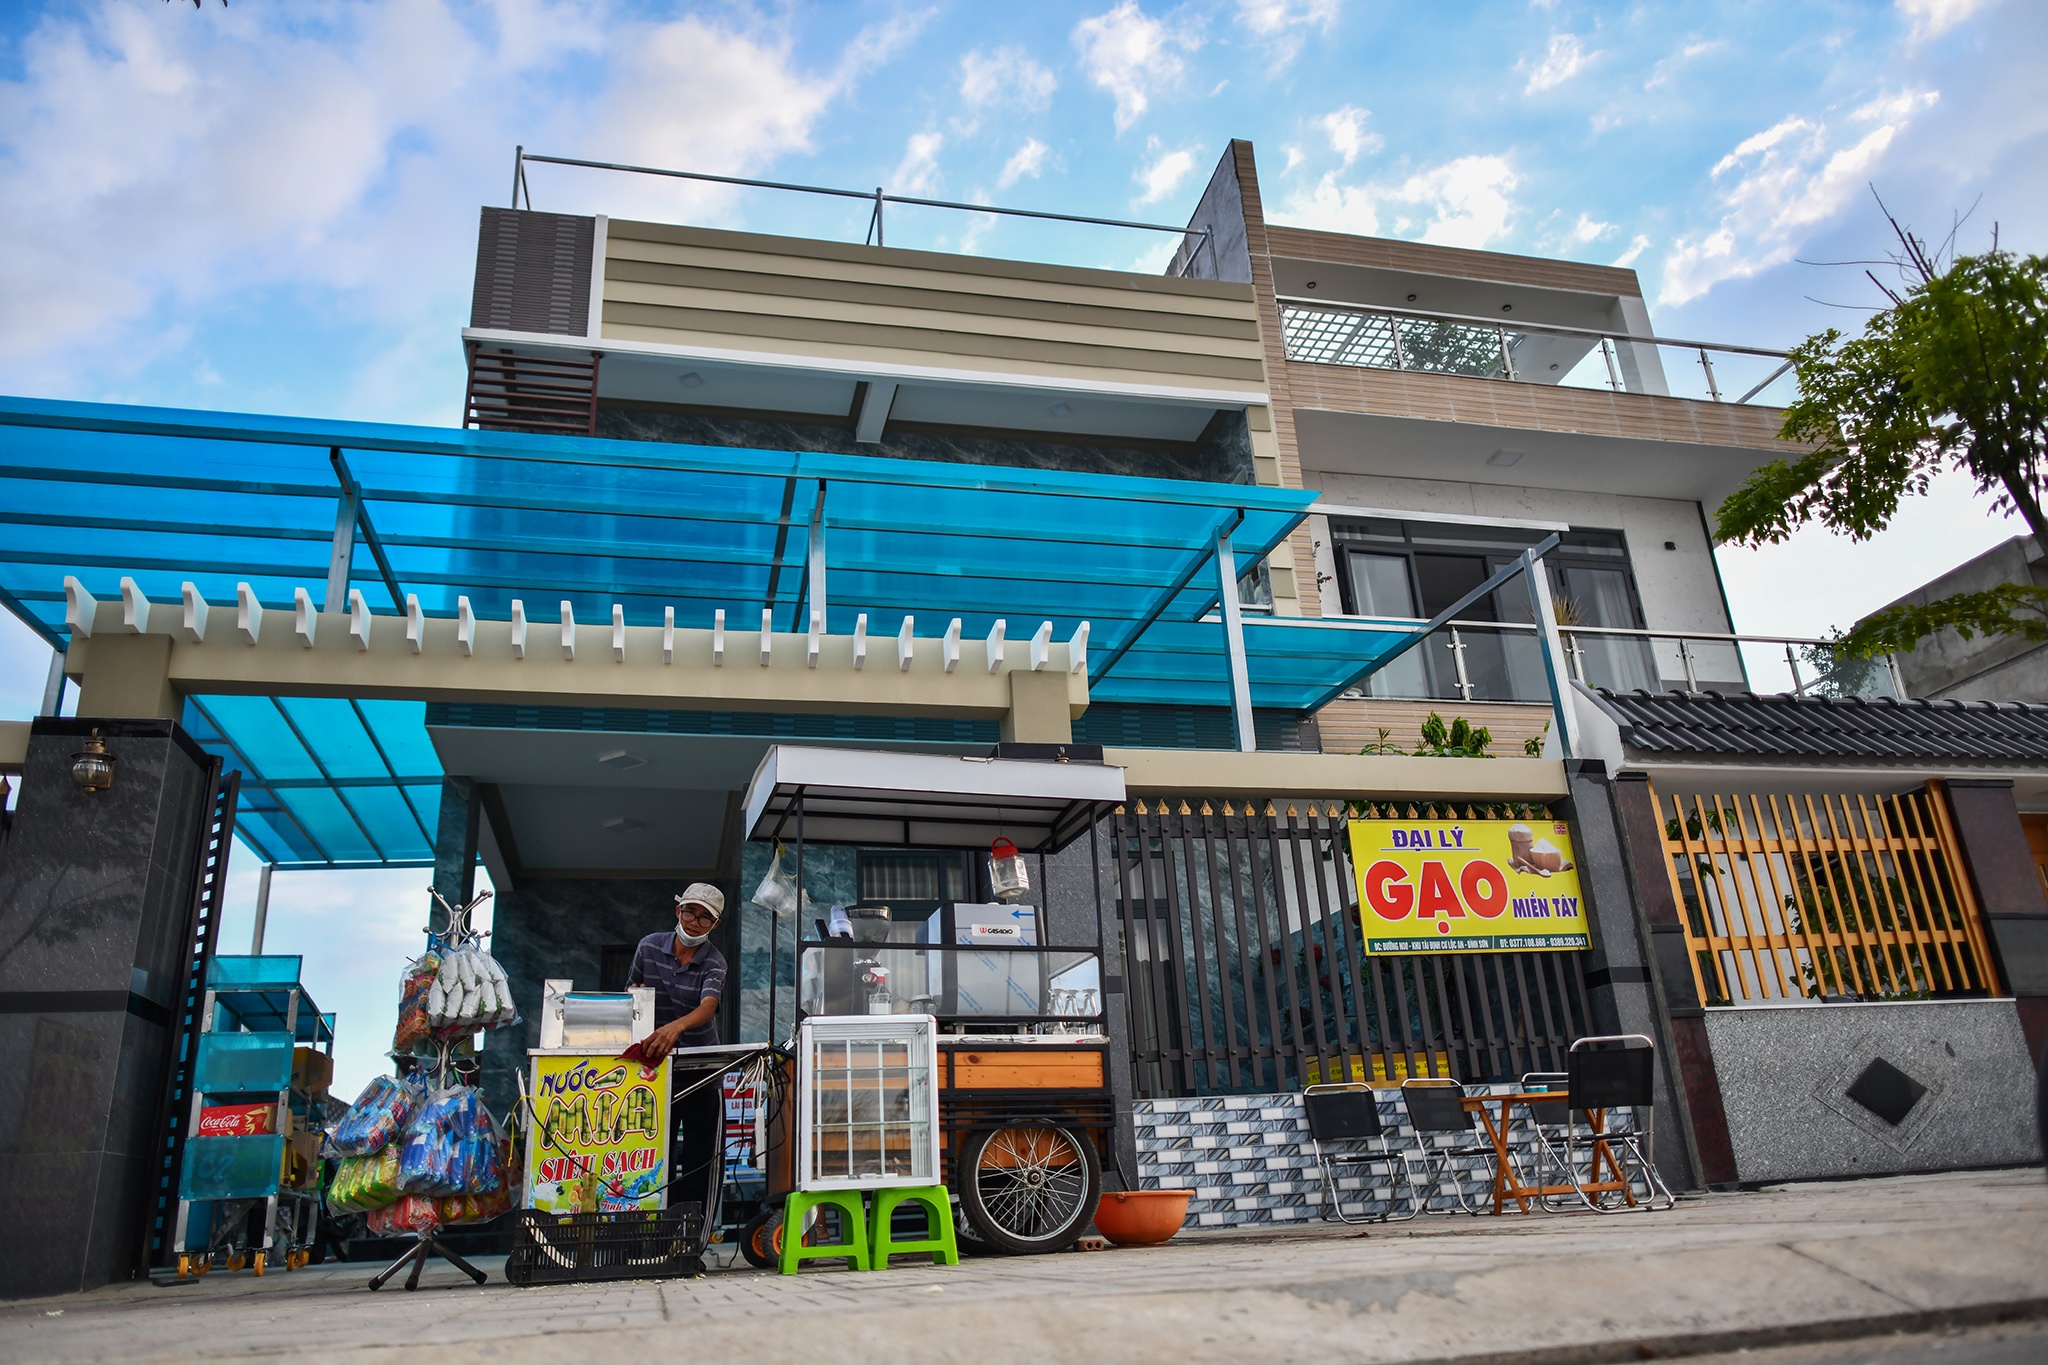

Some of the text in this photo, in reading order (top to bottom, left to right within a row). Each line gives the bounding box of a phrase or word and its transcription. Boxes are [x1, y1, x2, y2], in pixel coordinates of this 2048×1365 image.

[1392, 825, 1464, 851] ĐẠI LÝ
[1365, 860, 1508, 934] GẠO
[1512, 891, 1578, 918] MIỀN TÂY
[540, 1059, 599, 1097] NƯỚC
[540, 1065, 659, 1151] MÍA
[537, 1148, 657, 1184] SIÊU SẠCH
